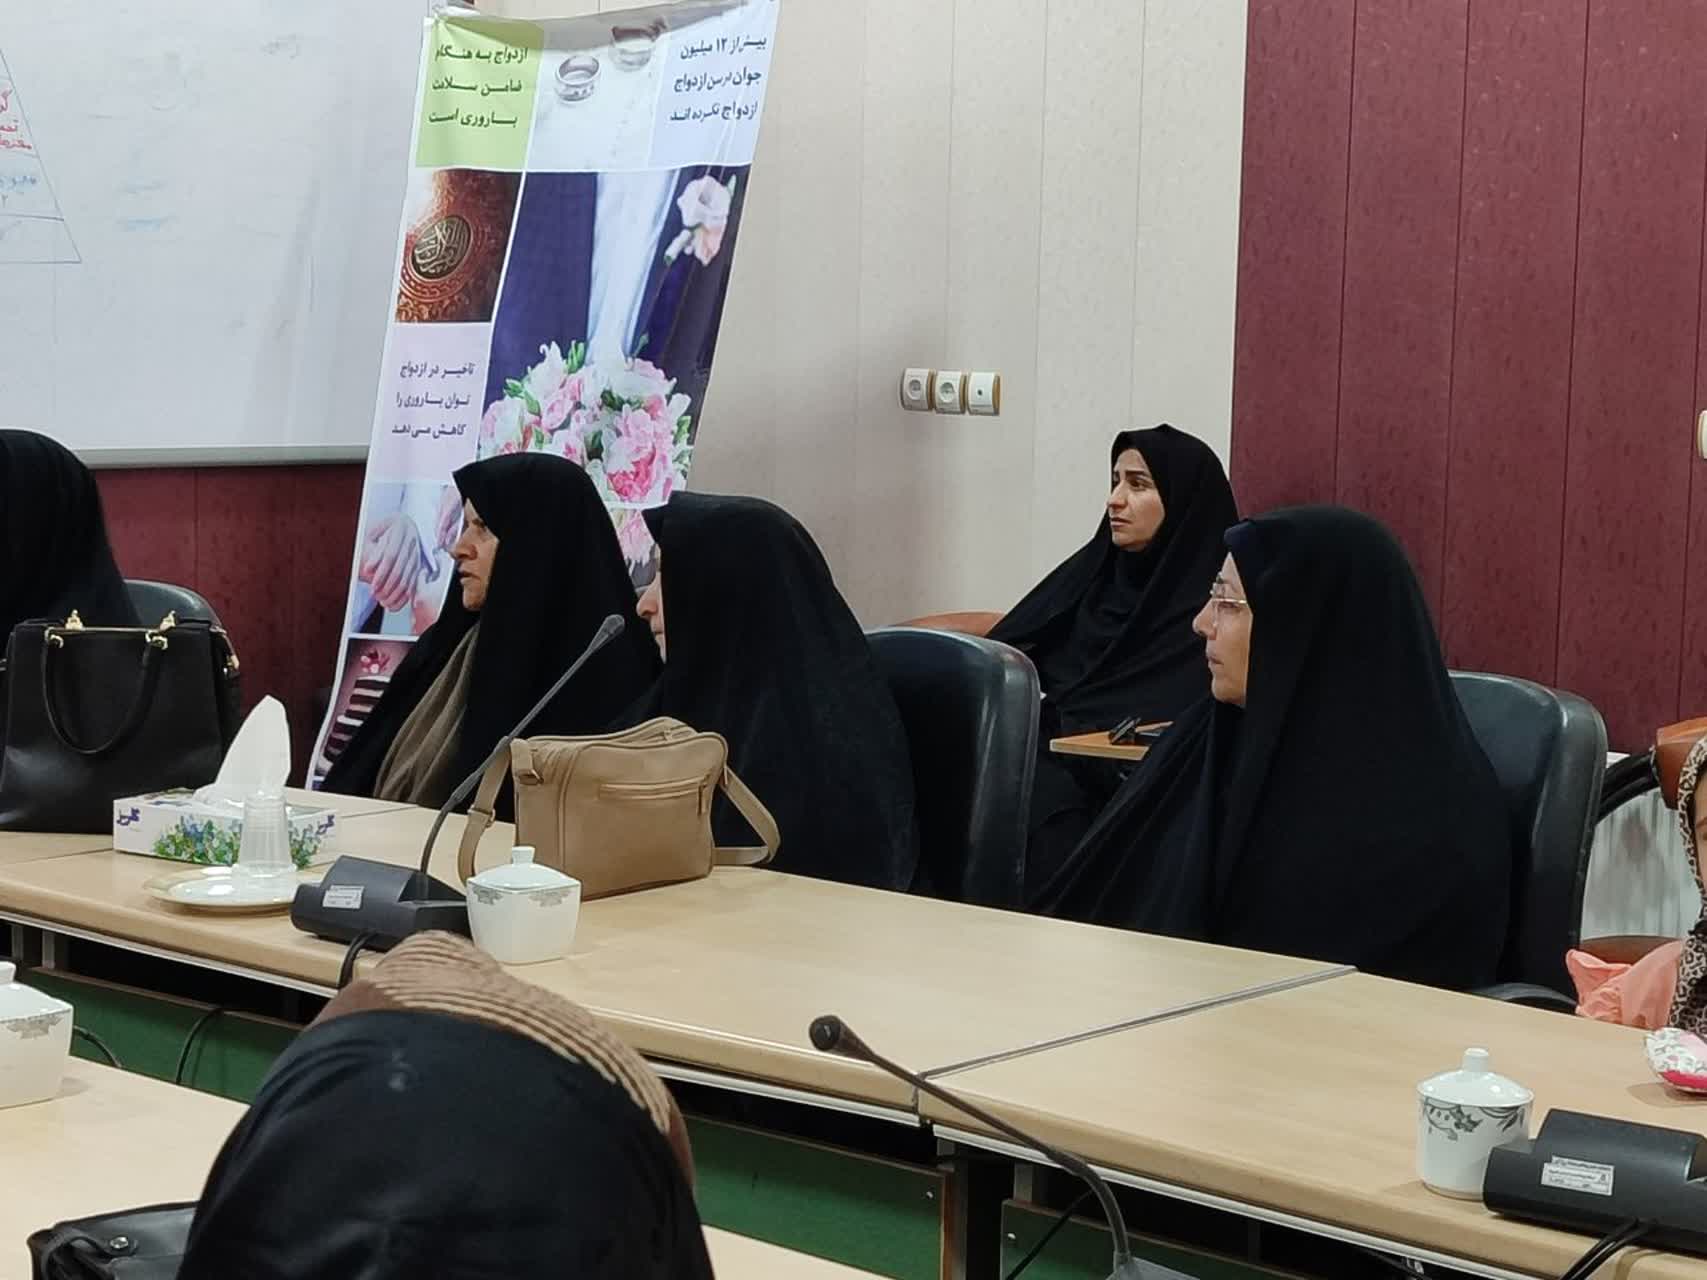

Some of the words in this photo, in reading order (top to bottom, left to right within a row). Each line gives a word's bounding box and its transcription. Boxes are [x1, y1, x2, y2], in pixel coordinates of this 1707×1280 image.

[436, 45, 472, 62] هنگام
[476, 50, 491, 63] به
[494, 47, 528, 64] ازدواج
[681, 40, 712, 59] میلیون
[432, 76, 477, 91] سلامت
[674, 72, 707, 93] ازدواج
[733, 67, 761, 86] جوان
[481, 78, 522, 97] ضامن
[428, 107, 459, 123] است
[670, 107, 691, 121] اند
[722, 101, 758, 121] ازدواج
[460, 112, 517, 129] باروری
[400, 361, 427, 379] ازدواج
[428, 365, 439, 379] در
[396, 392, 402, 408] را
[404, 392, 443, 409] باروری
[445, 392, 471, 410] توان
[432, 423, 466, 440] کاهش
